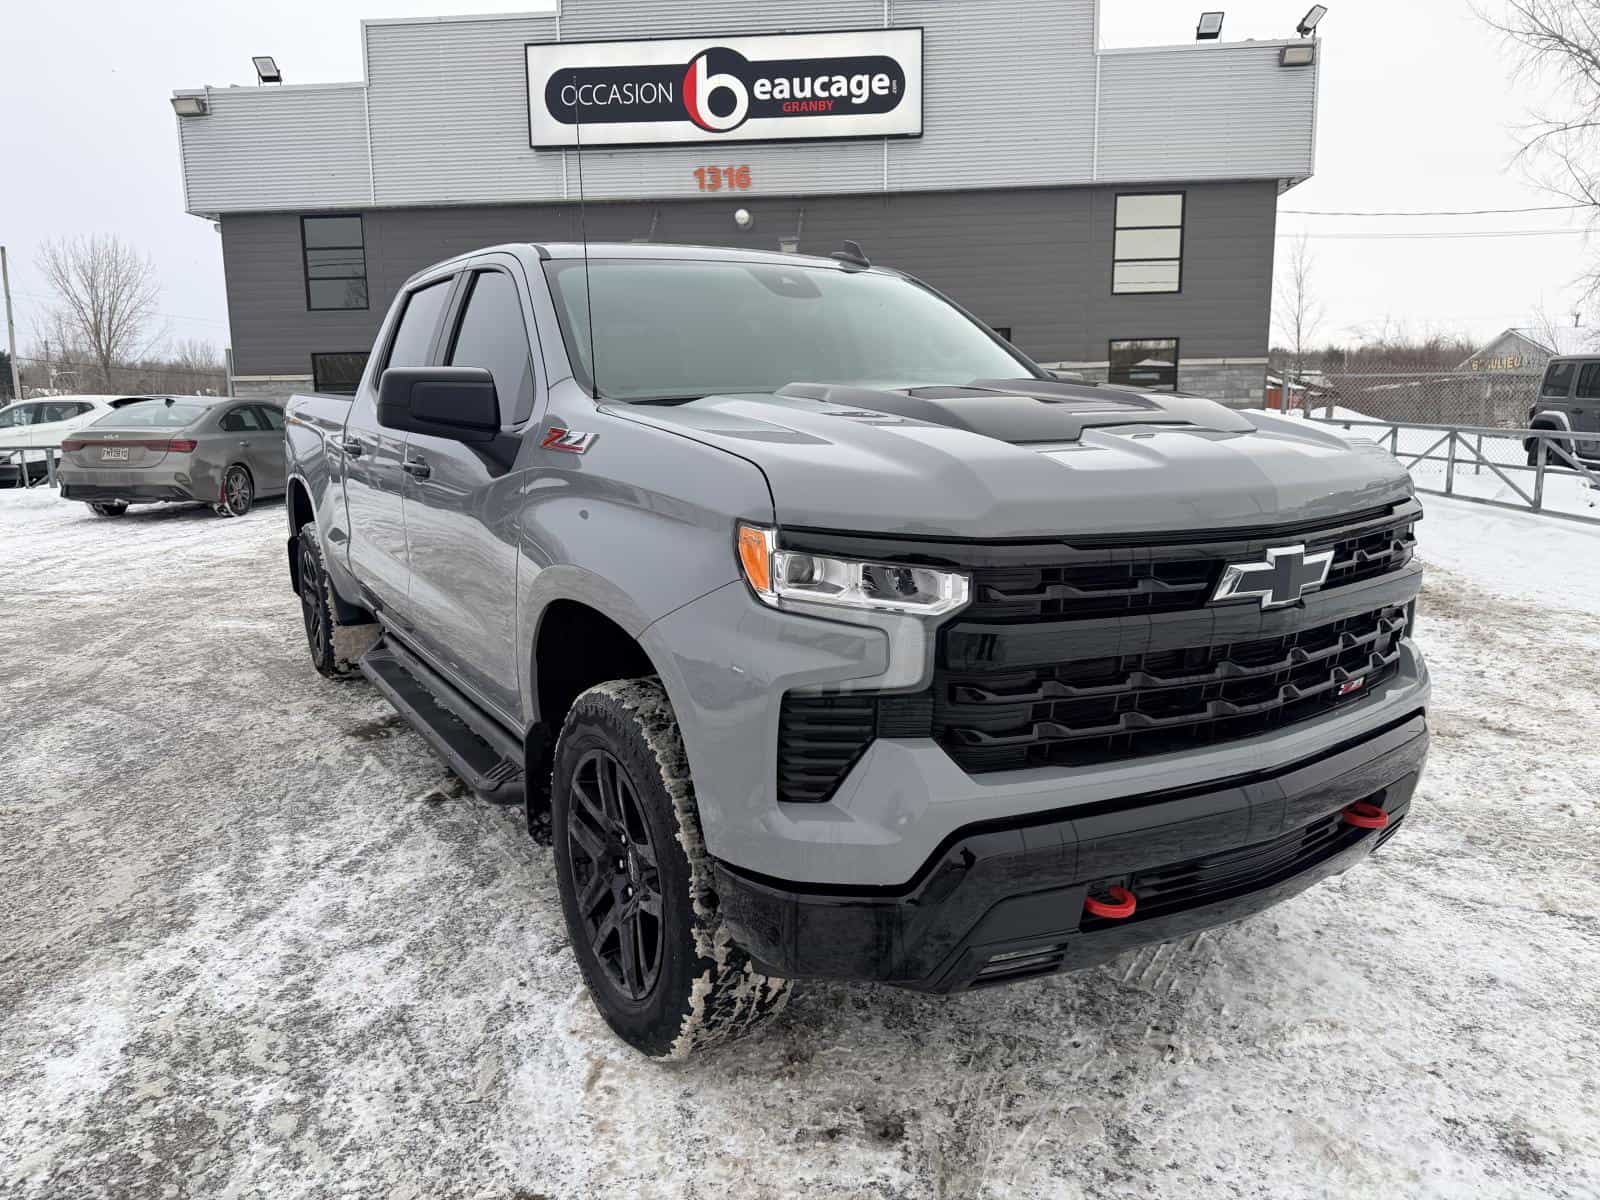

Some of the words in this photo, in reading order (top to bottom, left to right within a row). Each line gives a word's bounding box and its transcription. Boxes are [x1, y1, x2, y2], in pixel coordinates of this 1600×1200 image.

[561, 82, 673, 106] OCCASION
[783, 100, 833, 112] GRANBY
[692, 165, 752, 191] 1316
